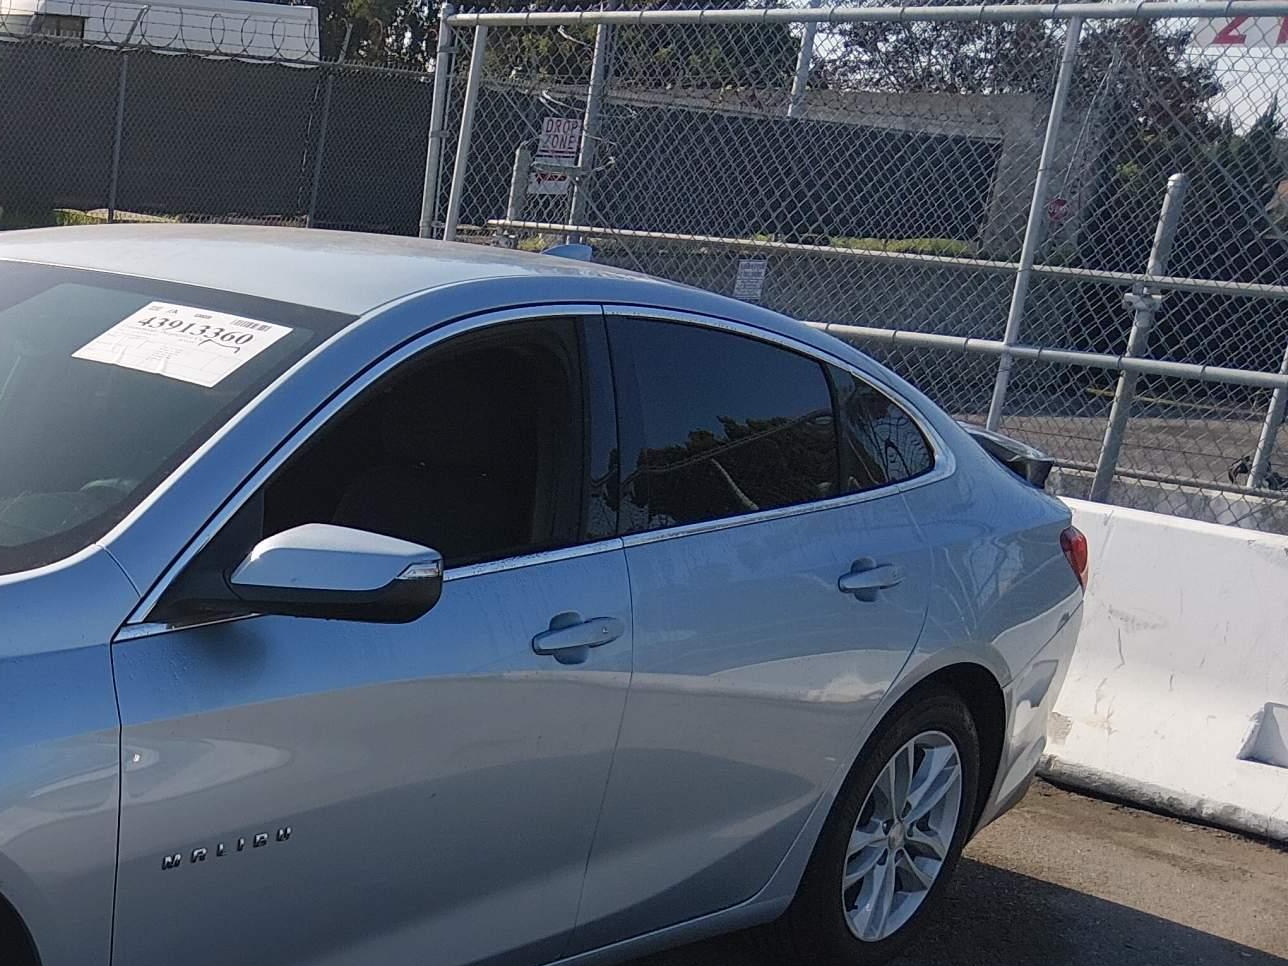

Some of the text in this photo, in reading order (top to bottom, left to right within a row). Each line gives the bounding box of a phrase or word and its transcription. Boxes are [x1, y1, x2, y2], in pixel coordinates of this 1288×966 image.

[546, 119, 579, 134] DROP
[541, 133, 577, 150] ZONE
[138, 316, 254, 345] 43913360
[161, 826, 292, 871] MALIBU
